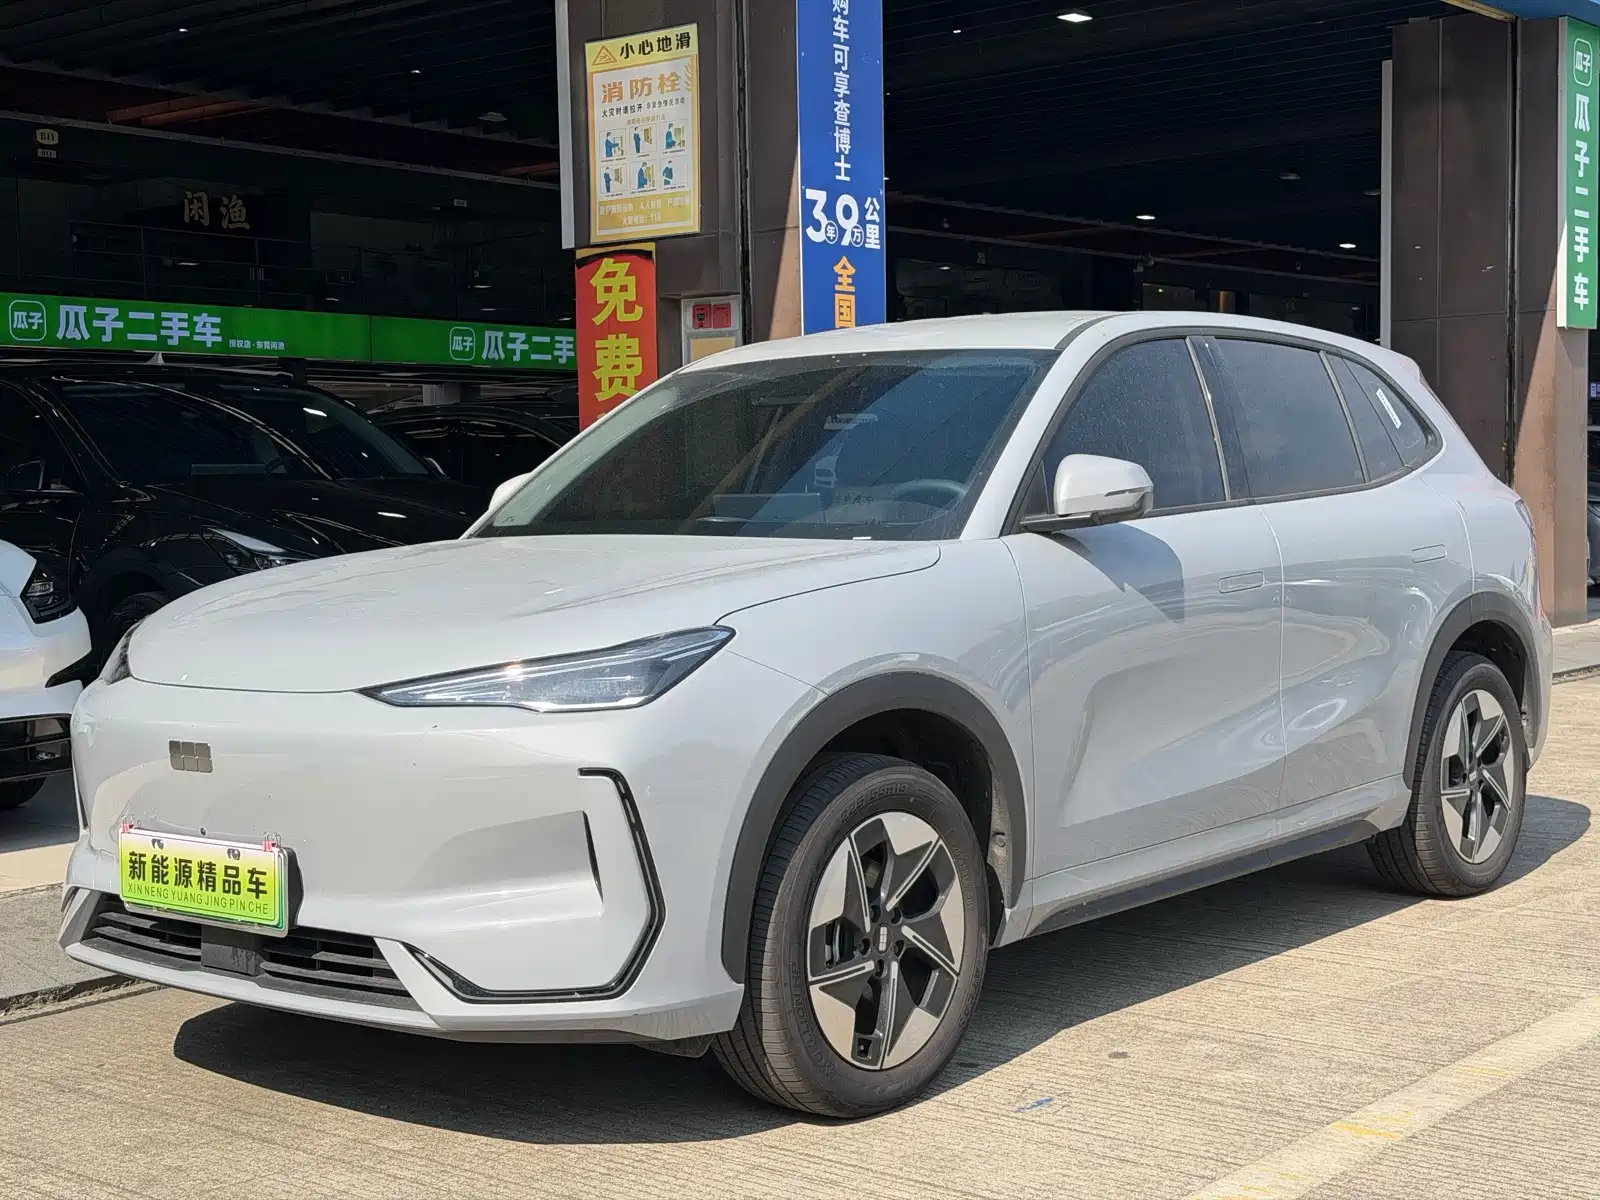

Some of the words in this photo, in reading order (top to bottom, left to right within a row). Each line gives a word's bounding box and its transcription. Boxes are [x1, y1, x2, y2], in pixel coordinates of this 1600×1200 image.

[620, 32, 691, 59] 小心地滑
[1575, 51, 1591, 73] 瓜子
[601, 71, 681, 104] 消防栓
[601, 103, 643, 118] 火灾时请拉开
[183, 191, 251, 230] 闲渔
[1574, 93, 1590, 311] 瓜子二手车
[833, 256, 856, 328] 全国
[13, 311, 44, 330] 瓜子
[56, 304, 223, 348] 瓜子二手车
[452, 336, 473, 351] 瓜子
[481, 330, 575, 364] 瓜子二手
[589, 258, 644, 418] 免费
[128, 851, 268, 899] 新能源精品车
[127, 882, 143, 895] XIN
[144, 885, 169, 899] NENG
[171, 889, 203, 905] YUANG
[205, 895, 227, 908] JING
[229, 898, 246, 911] PIN
[248, 901, 268, 914] CHE
